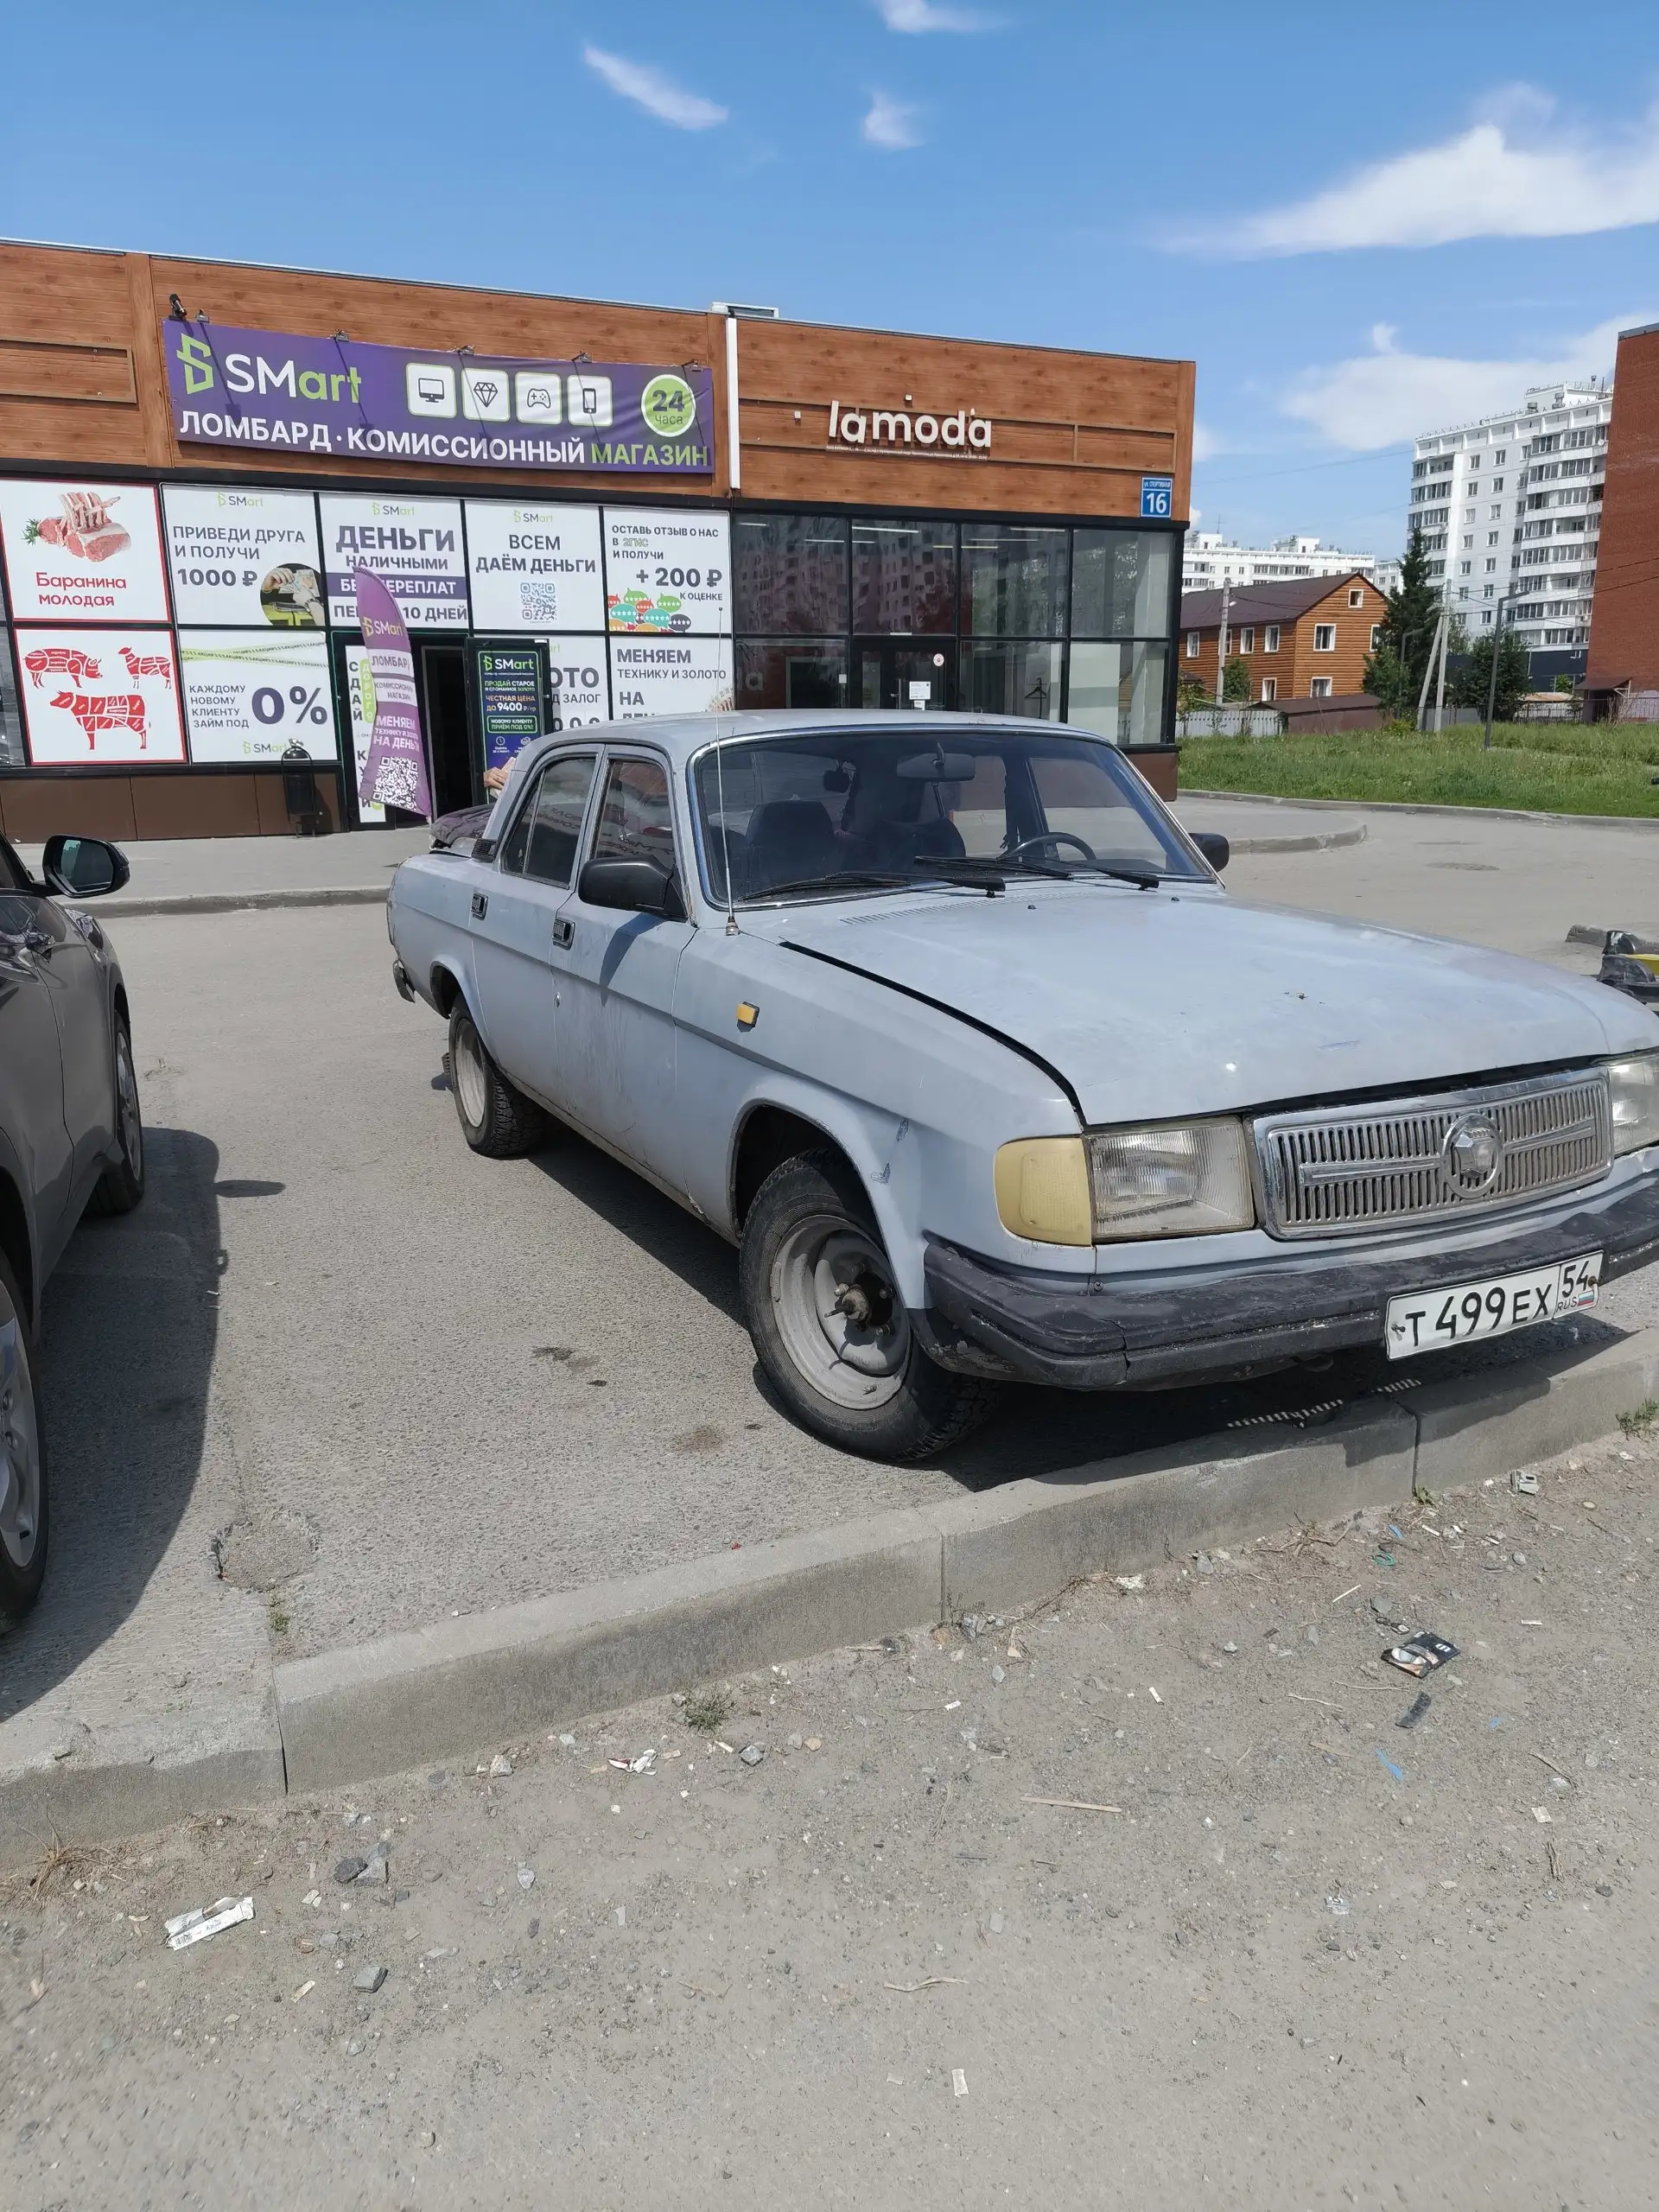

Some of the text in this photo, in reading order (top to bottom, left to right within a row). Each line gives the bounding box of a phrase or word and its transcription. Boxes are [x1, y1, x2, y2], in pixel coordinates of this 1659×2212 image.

[226, 353, 361, 404] SMart
[652, 389, 685, 412] 24
[654, 414, 683, 426] часа
[828, 400, 992, 448] lamoda
[180, 411, 708, 467] ЛОМБАРД КОМИССИОННЫЙ МАГАЗИН
[228, 495, 264, 507] SMart
[1146, 493, 1166, 514] 16
[383, 505, 415, 516] SMart
[523, 512, 553, 524] SMart
[173, 525, 305, 543] ПРИВЕДИ ДРУГА
[612, 524, 719, 537] ОСТАВЬ ОТЗЫВ О НАС
[335, 525, 454, 553] ДЕНЬГИ
[509, 534, 561, 550] ВСЕМ
[612, 537, 619, 546] В
[175, 544, 260, 560] И ПОЛУЧИ
[613, 550, 664, 560] И ПОЛУЧИ
[346, 555, 448, 570] НАЛИЧНЫМИ
[475, 554, 596, 574] ДАЁМ ДЕНЬГИ
[35, 572, 127, 590] Баранина
[177, 568, 237, 587] 1000
[655, 567, 701, 588] 200
[340, 578, 456, 594] БЕ ЕРЕПЛАТ
[39, 594, 115, 607] молодая
[688, 592, 723, 601] ОЦЕНКЕ
[403, 606, 467, 622] 10 ДНЕЙ
[372, 655, 410, 671] ЛОМБАР
[617, 648, 691, 664] МЕНЯЕМ
[494, 658, 534, 670] SMart
[618, 669, 727, 680] ТЕХНИКУ И ЗОЛОТО
[189, 684, 246, 695] КАЖДОМУ
[191, 696, 236, 705] НОВОМУ
[563, 693, 601, 703] ЗАЛОГ
[620, 691, 645, 706] НА
[192, 708, 240, 716] КЛИЕНТУ
[497, 702, 523, 711] 9400
[194, 719, 250, 728] ЗАЙМ ПОД
[377, 715, 416, 729] МЕНЯЕМ
[373, 735, 391, 747] НА
[1561, 1260, 1589, 1298] 54
[1555, 1297, 1578, 1313] RUS
